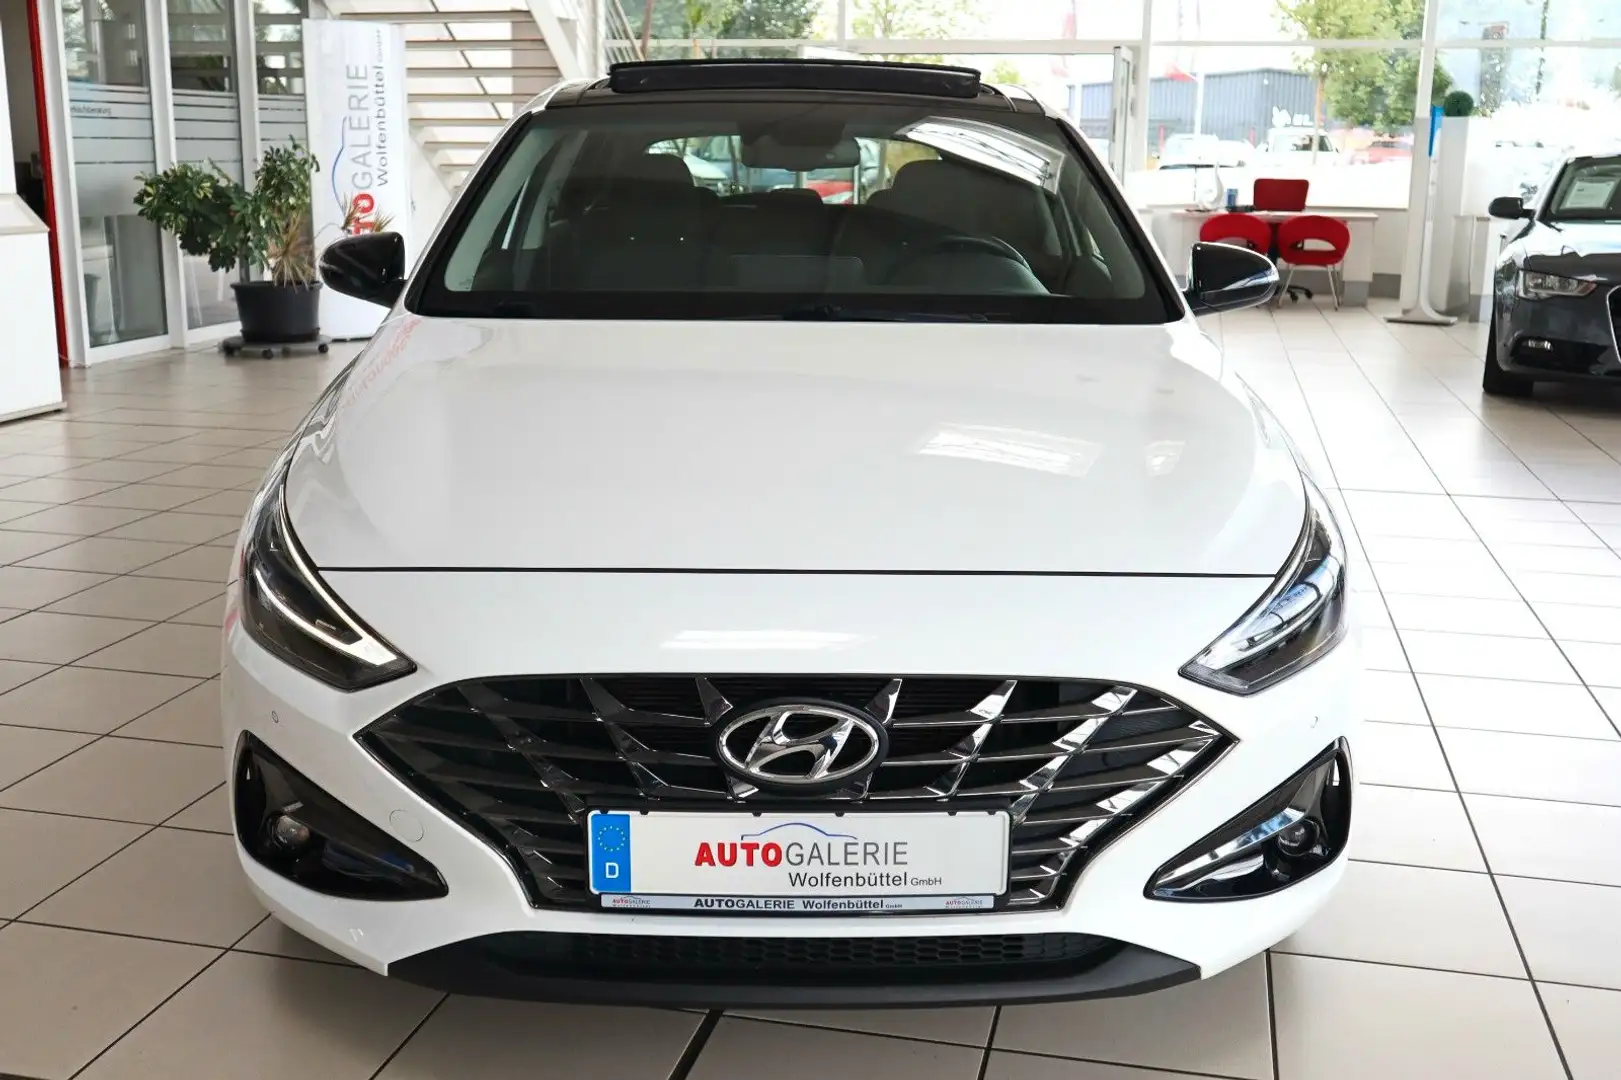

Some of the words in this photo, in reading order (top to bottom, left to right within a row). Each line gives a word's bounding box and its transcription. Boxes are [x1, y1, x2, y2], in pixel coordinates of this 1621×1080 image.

[372, 65, 388, 187] Wolfenbüttel
[346, 63, 375, 237] TOGALERIE
[694, 842, 908, 867] AUTOGALERIE
[605, 862, 619, 879] D
[788, 871, 908, 888] Wolfenbüttel
[910, 877, 942, 886] GmbH
[694, 898, 795, 909] AUTOGALERIE
[802, 899, 884, 909] Wolfenbüttel
